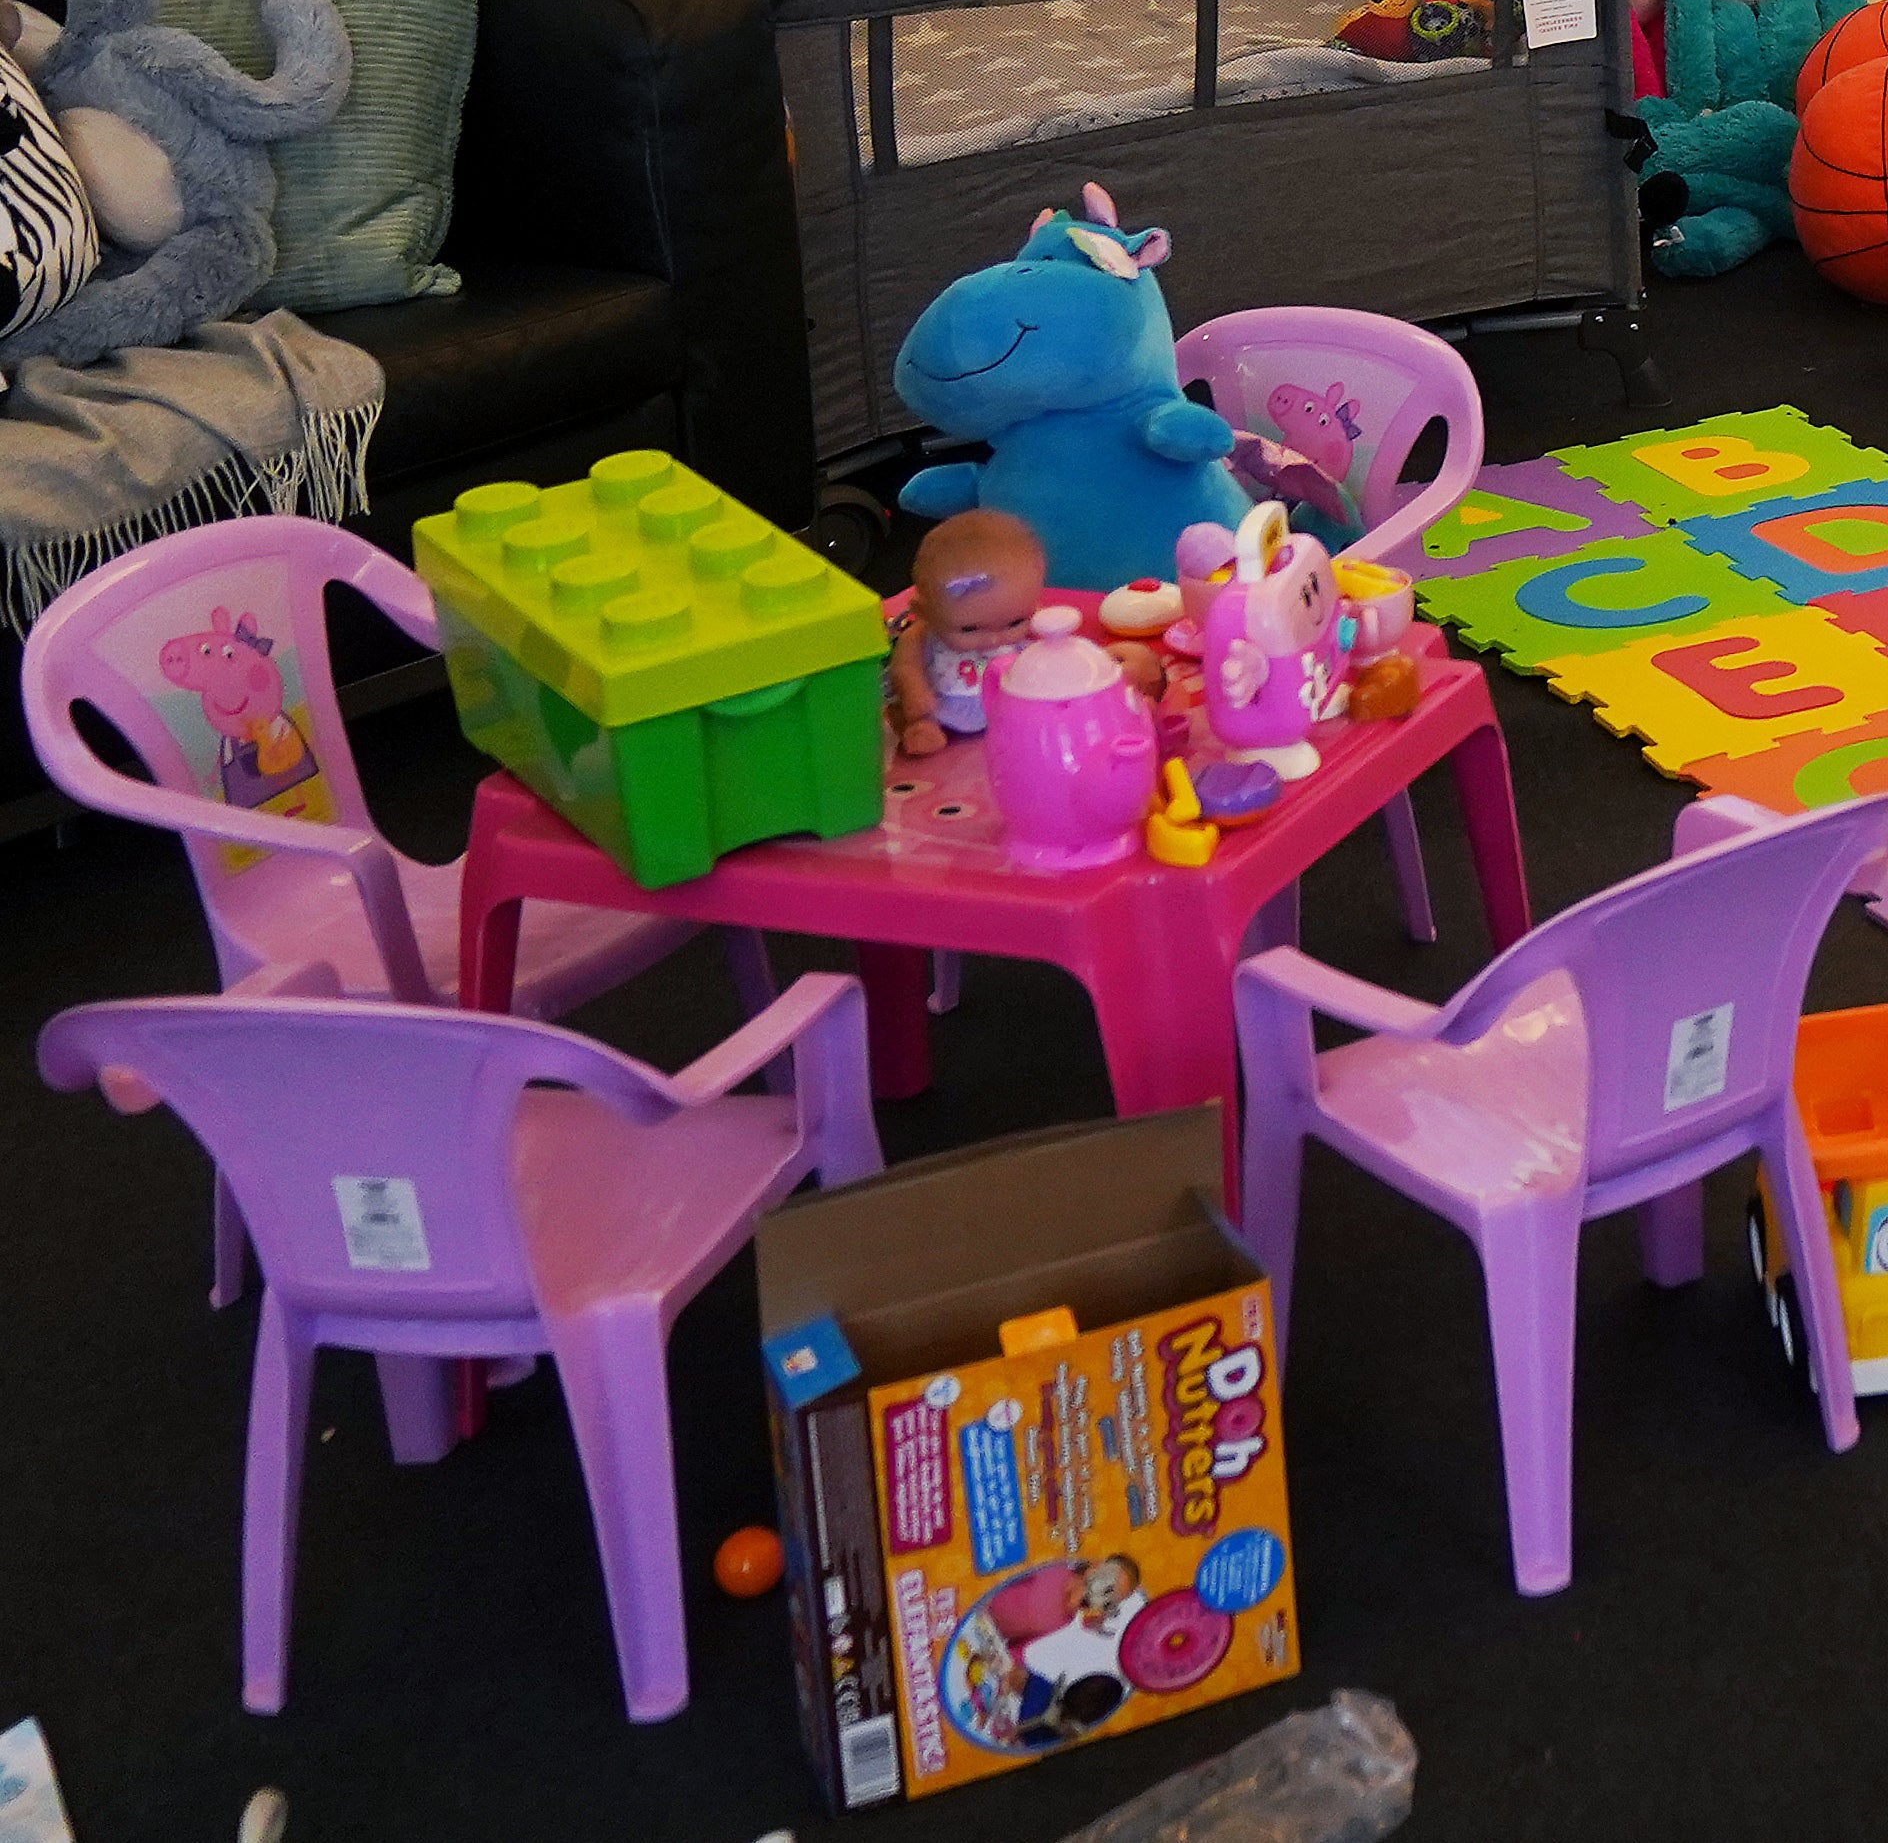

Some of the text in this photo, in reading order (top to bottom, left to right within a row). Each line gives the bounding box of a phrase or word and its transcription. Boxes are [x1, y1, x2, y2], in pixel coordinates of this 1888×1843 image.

[1631, 434, 1812, 498] B
[1421, 486, 1594, 560] A
[1515, 557, 1712, 630] C
[1651, 635, 1847, 721] E
[1165, 1322, 1222, 1524] Nutters
